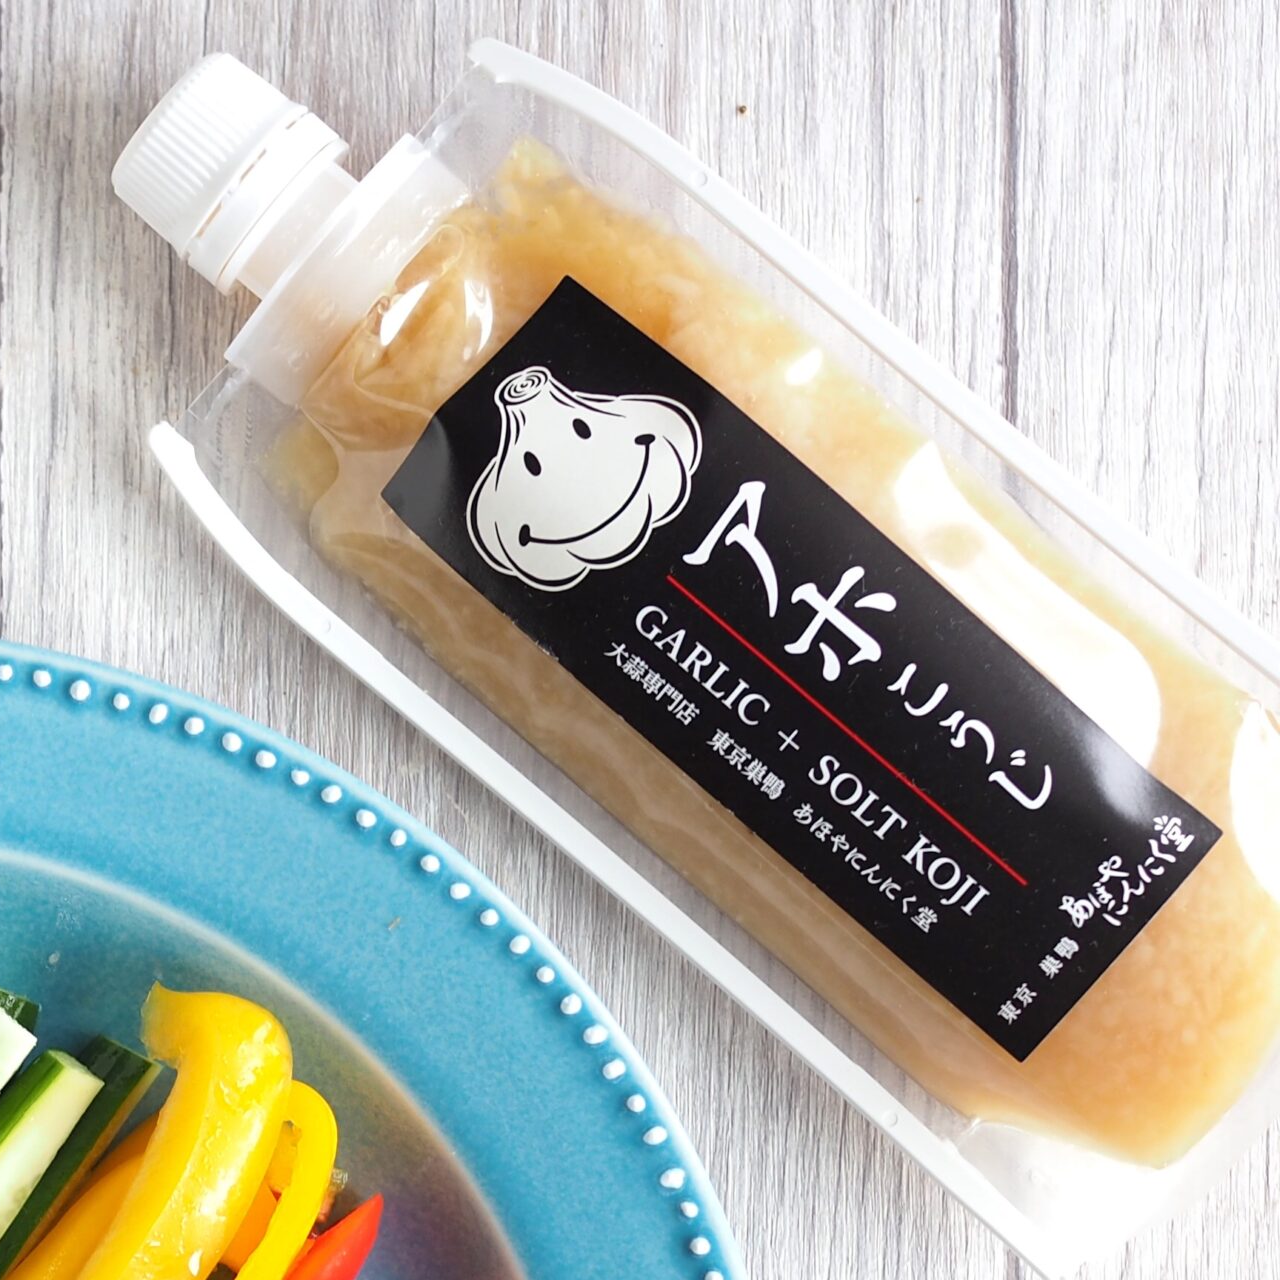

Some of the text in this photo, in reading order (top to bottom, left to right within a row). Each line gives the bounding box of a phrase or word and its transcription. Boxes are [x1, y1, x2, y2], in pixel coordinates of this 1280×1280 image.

[604, 642, 938, 933] 大蒜専門店 東京巣鴨 あほやにんにく堂
[635, 605, 771, 726] GARLIC
[808, 755, 908, 840] SOLT
[902, 834, 990, 916] KOJI
[682, 480, 1054, 810] アホこうじ
[997, 936, 1079, 1024] 東京 巣鴨
[1102, 814, 1195, 927] にんにく堂
